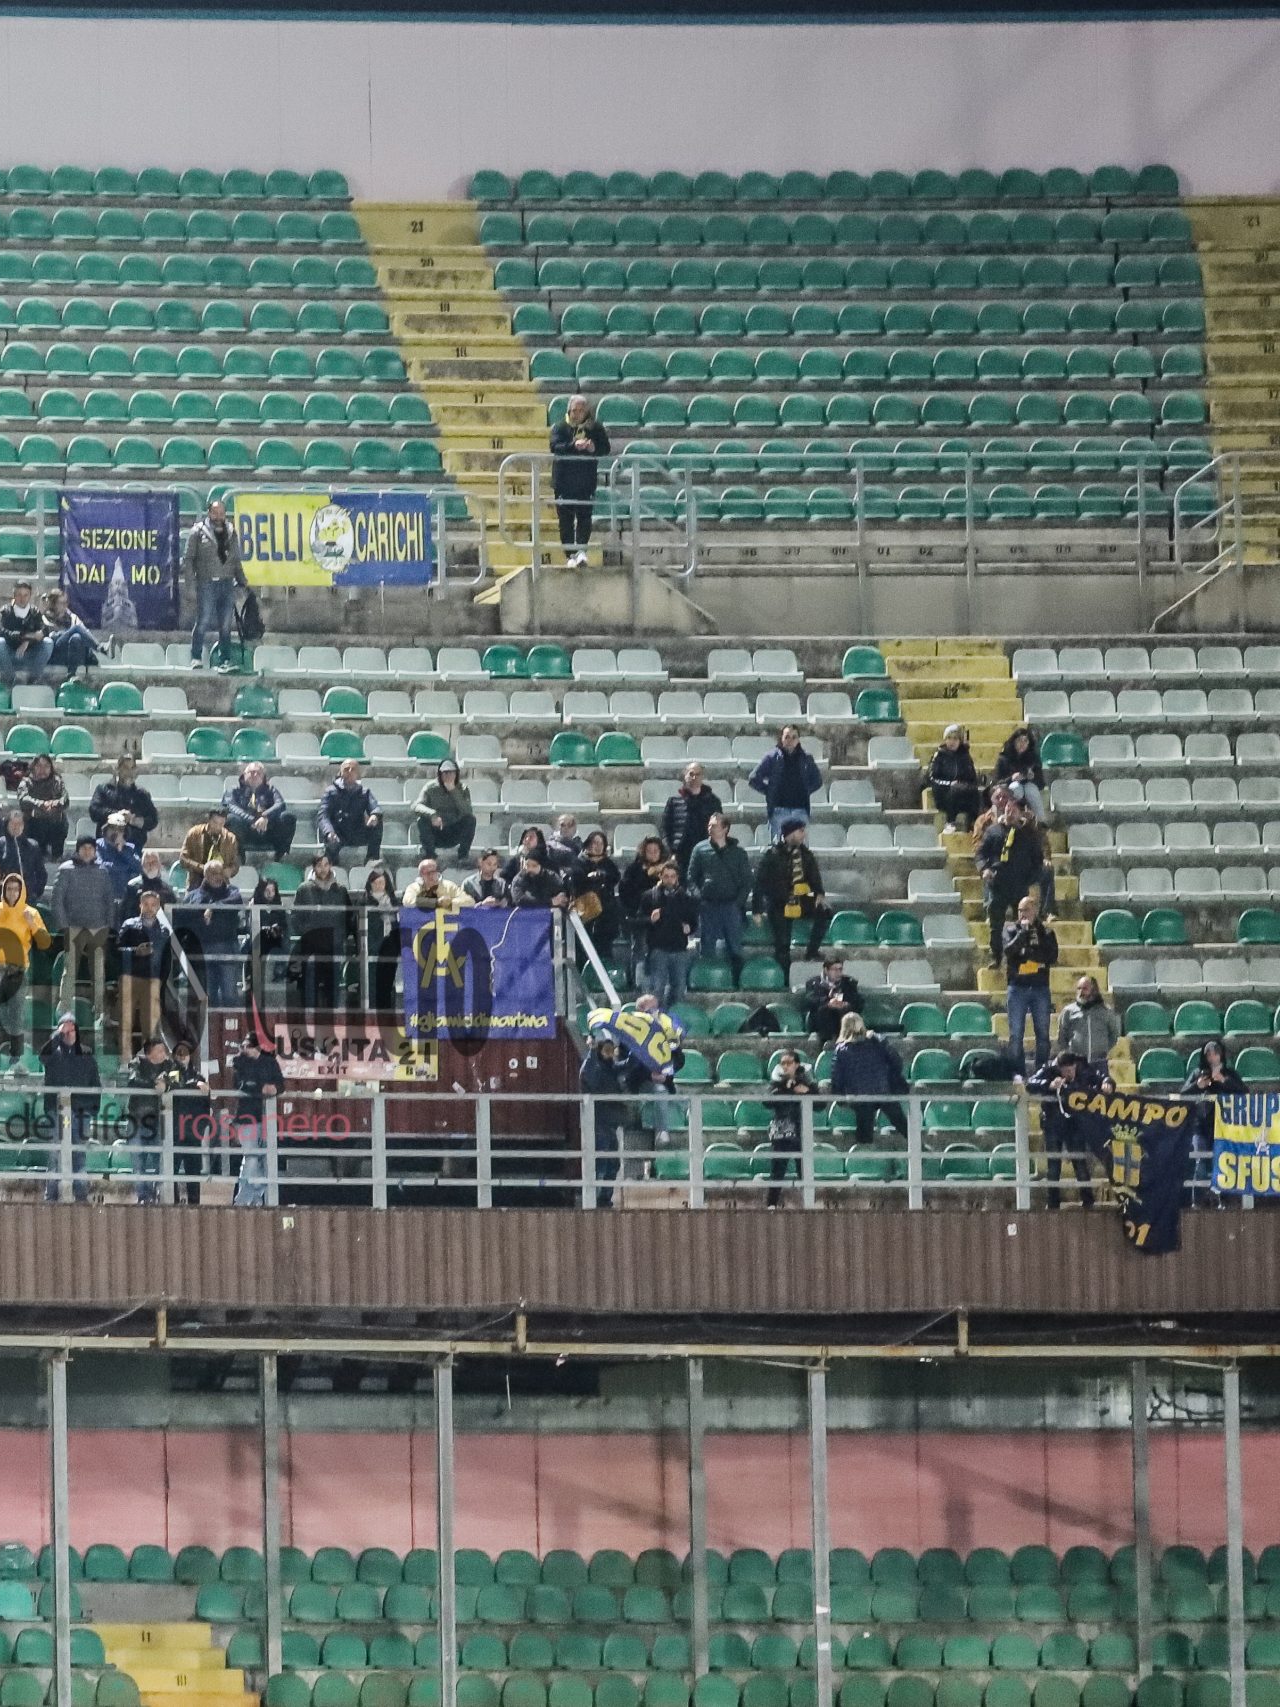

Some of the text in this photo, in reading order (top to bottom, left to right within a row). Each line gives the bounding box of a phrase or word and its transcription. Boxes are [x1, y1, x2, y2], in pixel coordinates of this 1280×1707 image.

[79, 527, 158, 552] SEZIONE
[239, 511, 425, 562] BELLI CARICHI
[397, 1041, 431, 1066] 21
[317, 1065, 349, 1075] EXIT
[1068, 1091, 1189, 1128] CAMPO
